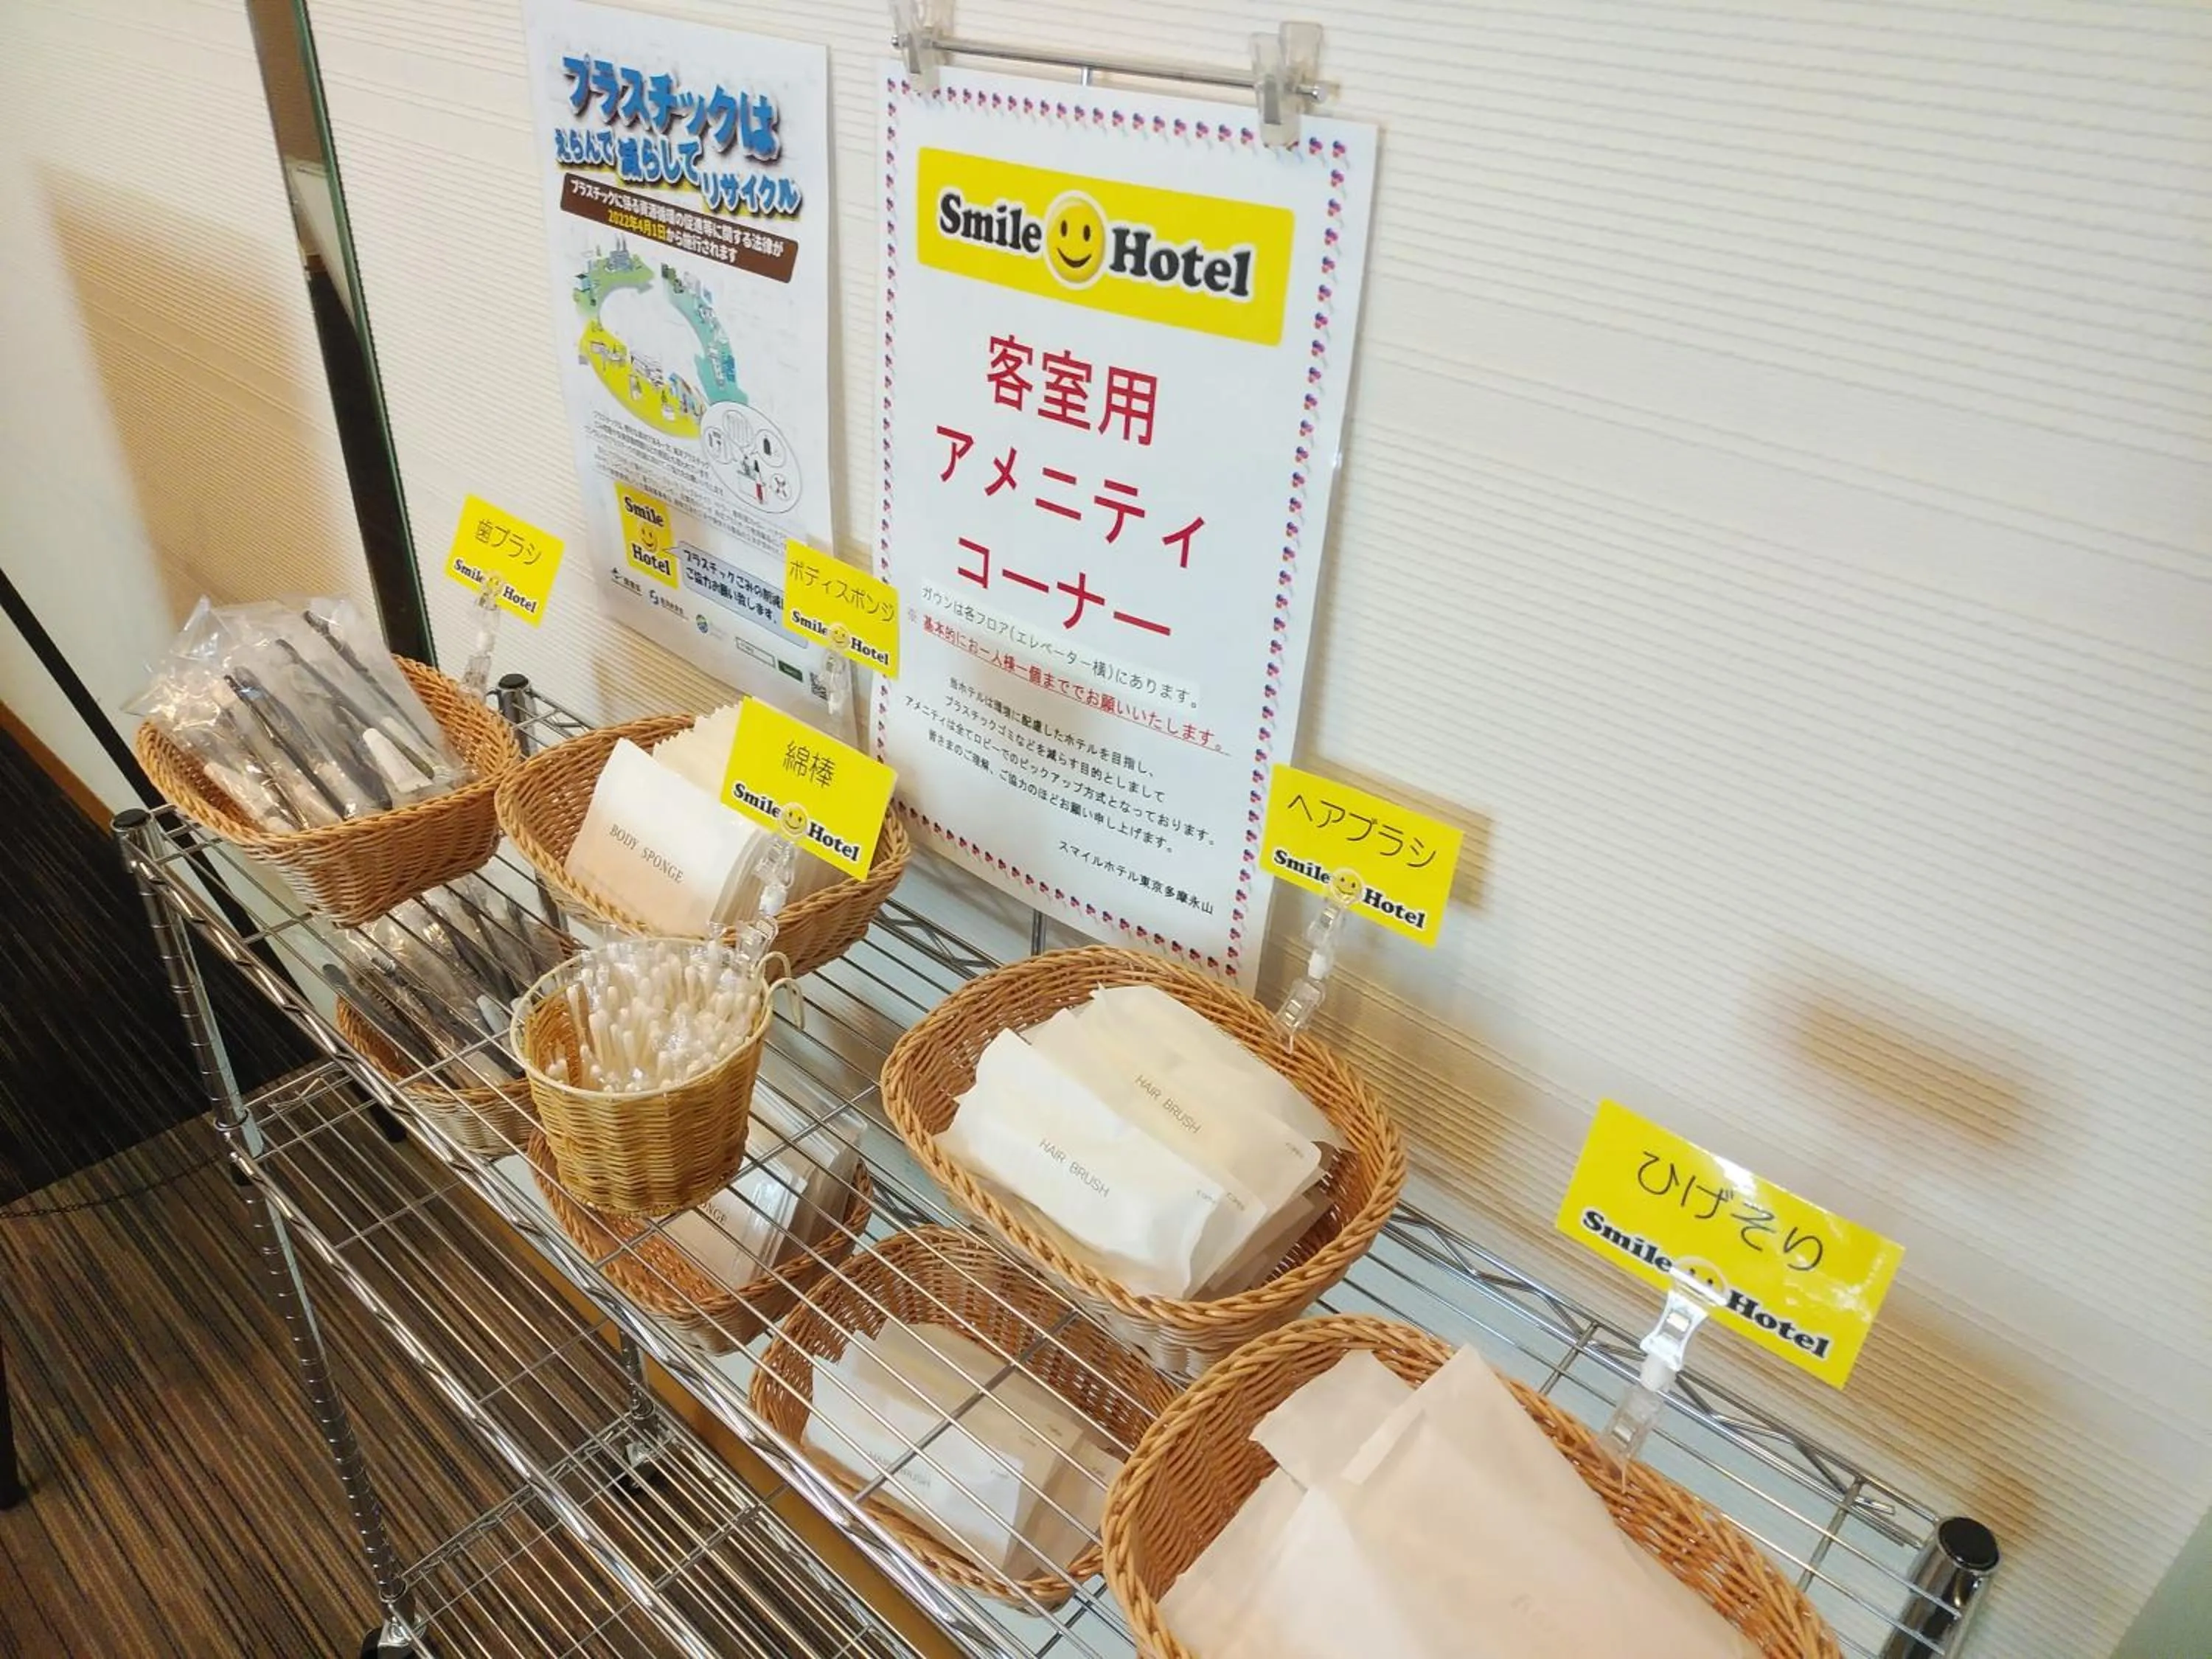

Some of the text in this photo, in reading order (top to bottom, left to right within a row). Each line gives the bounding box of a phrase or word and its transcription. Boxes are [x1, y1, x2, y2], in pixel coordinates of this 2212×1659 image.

[563, 53, 778, 157] プラスチックは
[554, 128, 613, 165] えらんで
[702, 170, 802, 215] リサイクル
[939, 192, 1252, 297] Smile Hotel
[987, 335, 1158, 447] 客室用
[624, 496, 664, 528] Smile
[936, 425, 1206, 568] アメニティ
[474, 518, 543, 566] 歯ブラシ
[631, 543, 672, 577] Hotel
[502, 585, 538, 613] Hotel
[957, 537, 1172, 636] コーナー
[850, 636, 890, 666] Hotel
[782, 740, 836, 789] 綿棒
[609, 824, 684, 883] BODY SPONGE
[733, 782, 861, 862] Smile Hotel
[1287, 793, 1437, 869] ヘアブラシ
[1059, 840, 1214, 915] スマイルホテル東京多摩永山
[1273, 849, 1426, 929] Smile Hotel
[1134, 1074, 1201, 1135] HAIR BRUSH
[1038, 1138, 1110, 1198] HAIR BRUSH
[1637, 1150, 1824, 1272] ひげそり
[1582, 1209, 1832, 1360] Smile Hotel
